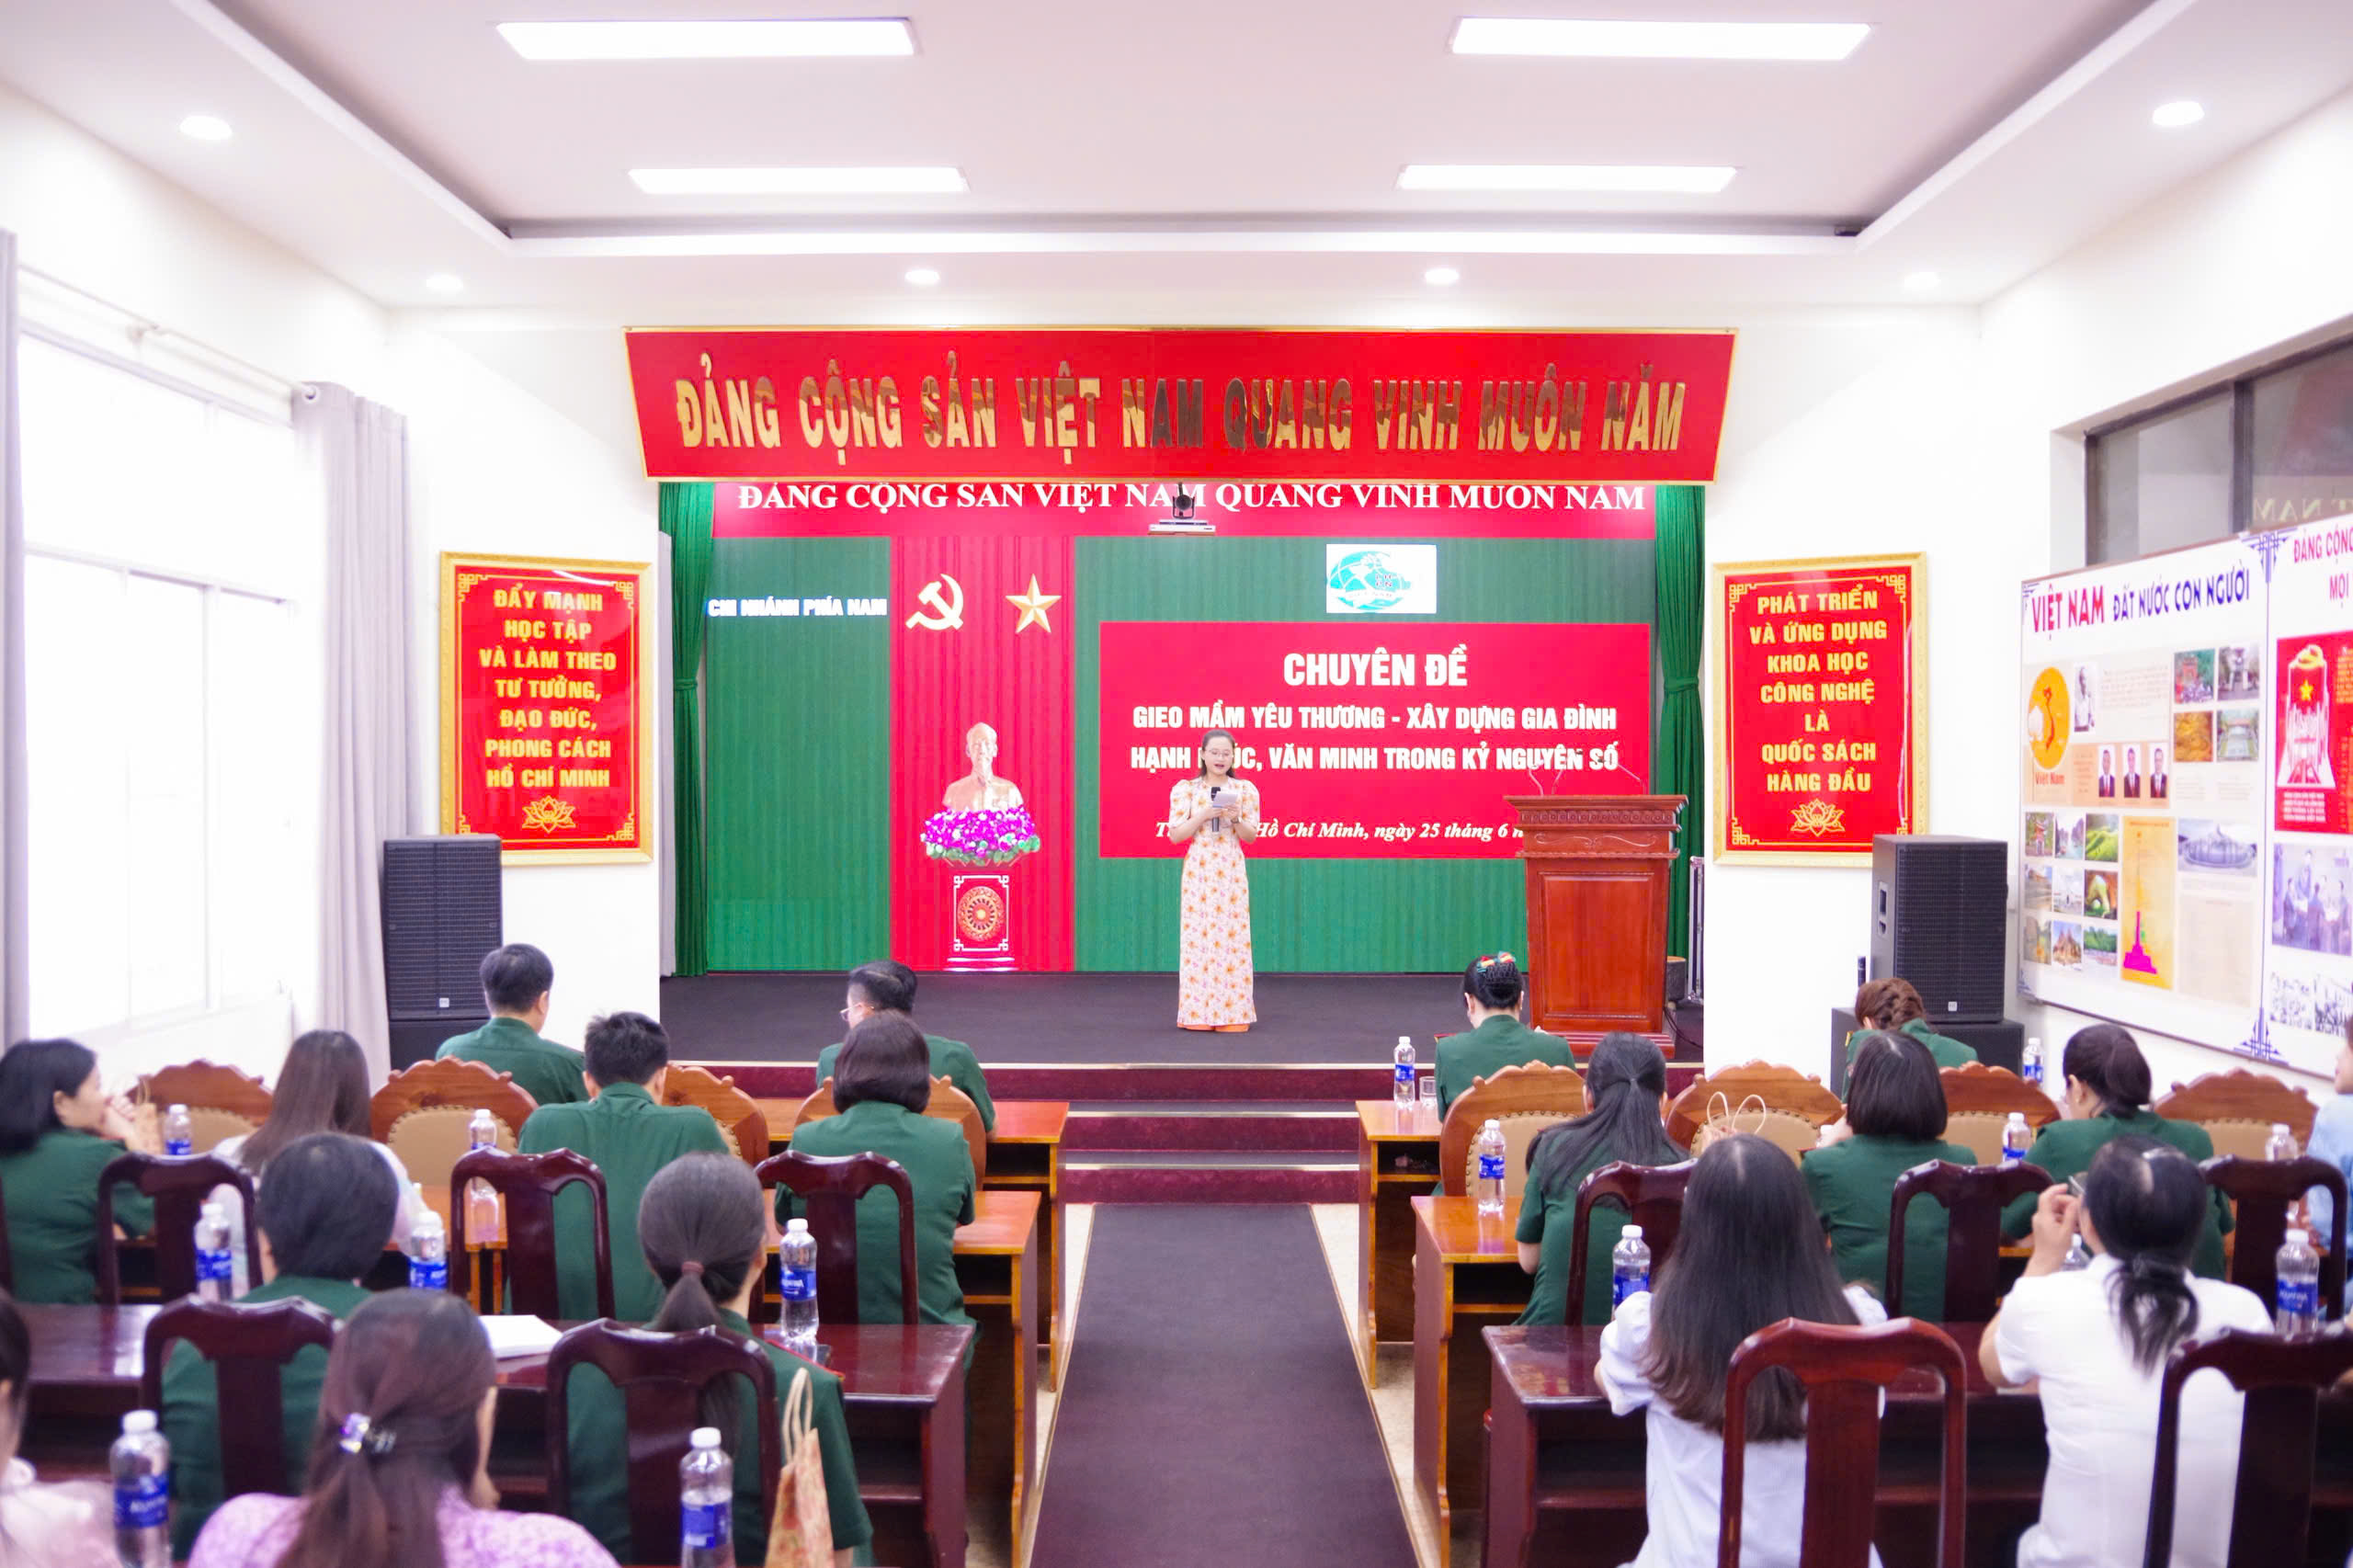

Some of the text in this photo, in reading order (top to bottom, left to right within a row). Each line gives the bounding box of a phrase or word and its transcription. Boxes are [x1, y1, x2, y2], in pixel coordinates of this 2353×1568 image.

[676, 350, 1686, 465] ĐẢNG CỘNG SẢN VIỆT NAM QUANG VINH MUÔN NĂM
[1215, 483, 1343, 512] QUANG
[1350, 484, 1440, 508] VINH
[494, 583, 603, 613] ĐẨY MẠNH
[1758, 584, 1878, 614] PHÁT TRIỂN
[2031, 583, 2063, 641] VIỆT
[2068, 585, 2105, 629] NAM
[2175, 578, 2201, 612] CON
[506, 619, 591, 643] HỌC TẬP
[1750, 621, 1886, 643] VÀ ỨNG DỤNG
[480, 646, 616, 669] VÀ LÀM THEO
[1284, 644, 1467, 686] CHUYÊN ĐỀ
[1768, 652, 1868, 674] KHOA HỌC
[495, 676, 601, 701] TƯ TƯỞNG,
[1761, 679, 1874, 704] CÔNG NGHỆ
[500, 708, 597, 732] ĐẠO ĐỨC,
[1133, 706, 1182, 728] GIEO
[1189, 699, 1245, 728] MẦM
[1251, 702, 1292, 728] YÊU
[1299, 705, 1384, 729] THƯƠNG
[1406, 703, 1449, 728] XÂY
[1456, 706, 1515, 733] DỰNG
[1522, 708, 1558, 729] GIA
[1563, 704, 1616, 729] ĐÌNH
[1805, 710, 1829, 731] LÀ
[485, 737, 610, 757] PHONG CÁCH
[1131, 747, 1190, 773] HẠNH
[1268, 744, 1313, 768] VĂN
[1320, 747, 1378, 768] MINH
[1384, 747, 1455, 769] TRONG
[1462, 741, 1490, 769] KỶ
[1496, 744, 1583, 769] NGUYÊN
[1589, 741, 1619, 770] SỐ
[1762, 739, 1875, 764] QUỐC SÁCH
[487, 764, 609, 787] HỒ CHÍ MINH
[1768, 767, 1870, 791] HÀNG ĐẦU
[1256, 818, 1279, 837] Hồ
[1284, 823, 1315, 837] Chí
[1318, 823, 1369, 839] Minh,
[1374, 824, 1415, 841] ngày
[1419, 824, 1440, 837] 25
[1445, 823, 1493, 841] tháng
[1498, 824, 1508, 837] 6
